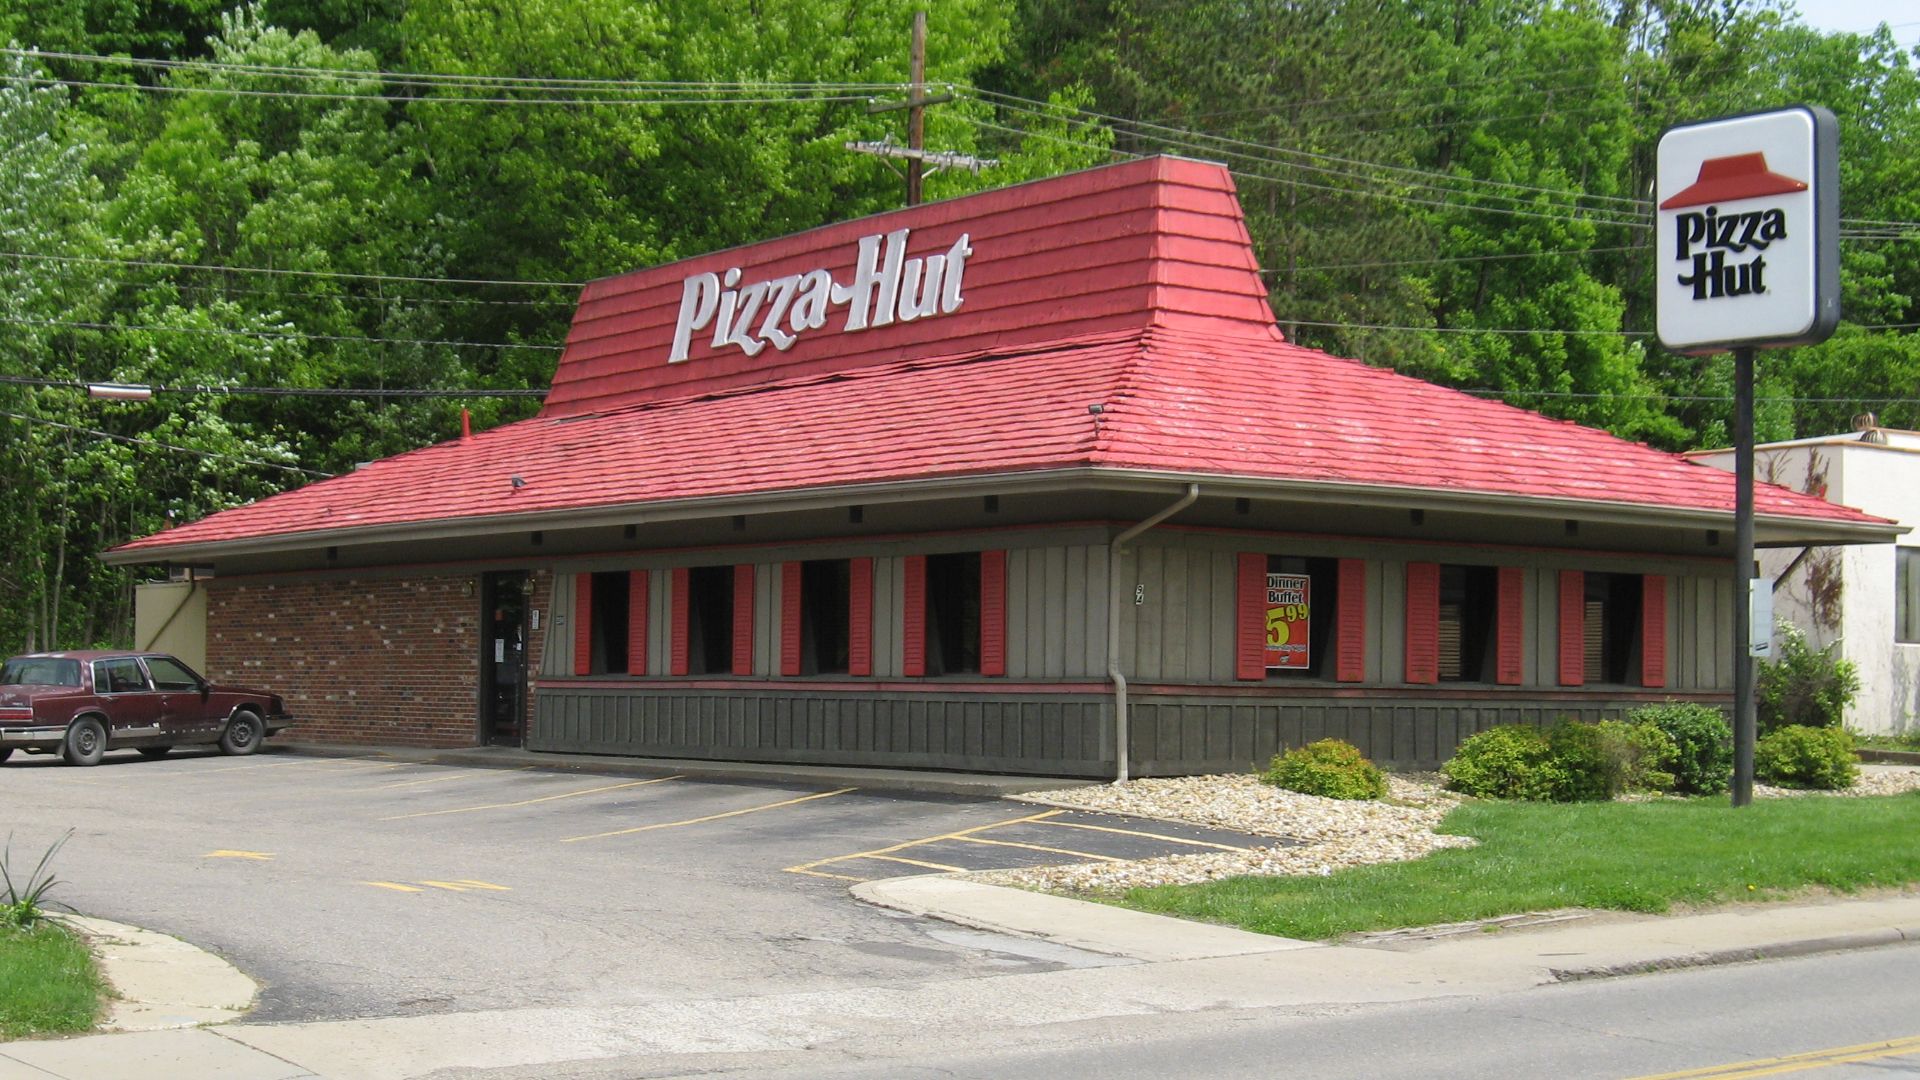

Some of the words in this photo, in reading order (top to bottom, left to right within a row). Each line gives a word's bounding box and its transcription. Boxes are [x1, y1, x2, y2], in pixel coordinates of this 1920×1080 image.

[1676, 206, 1787, 261] Pizza
[668, 267, 832, 363] Pizza
[831, 228, 973, 332] Hut
[1678, 250, 1767, 300] Hut
[1267, 576, 1306, 588] Dinner
[1268, 590, 1304, 603] Buffet
